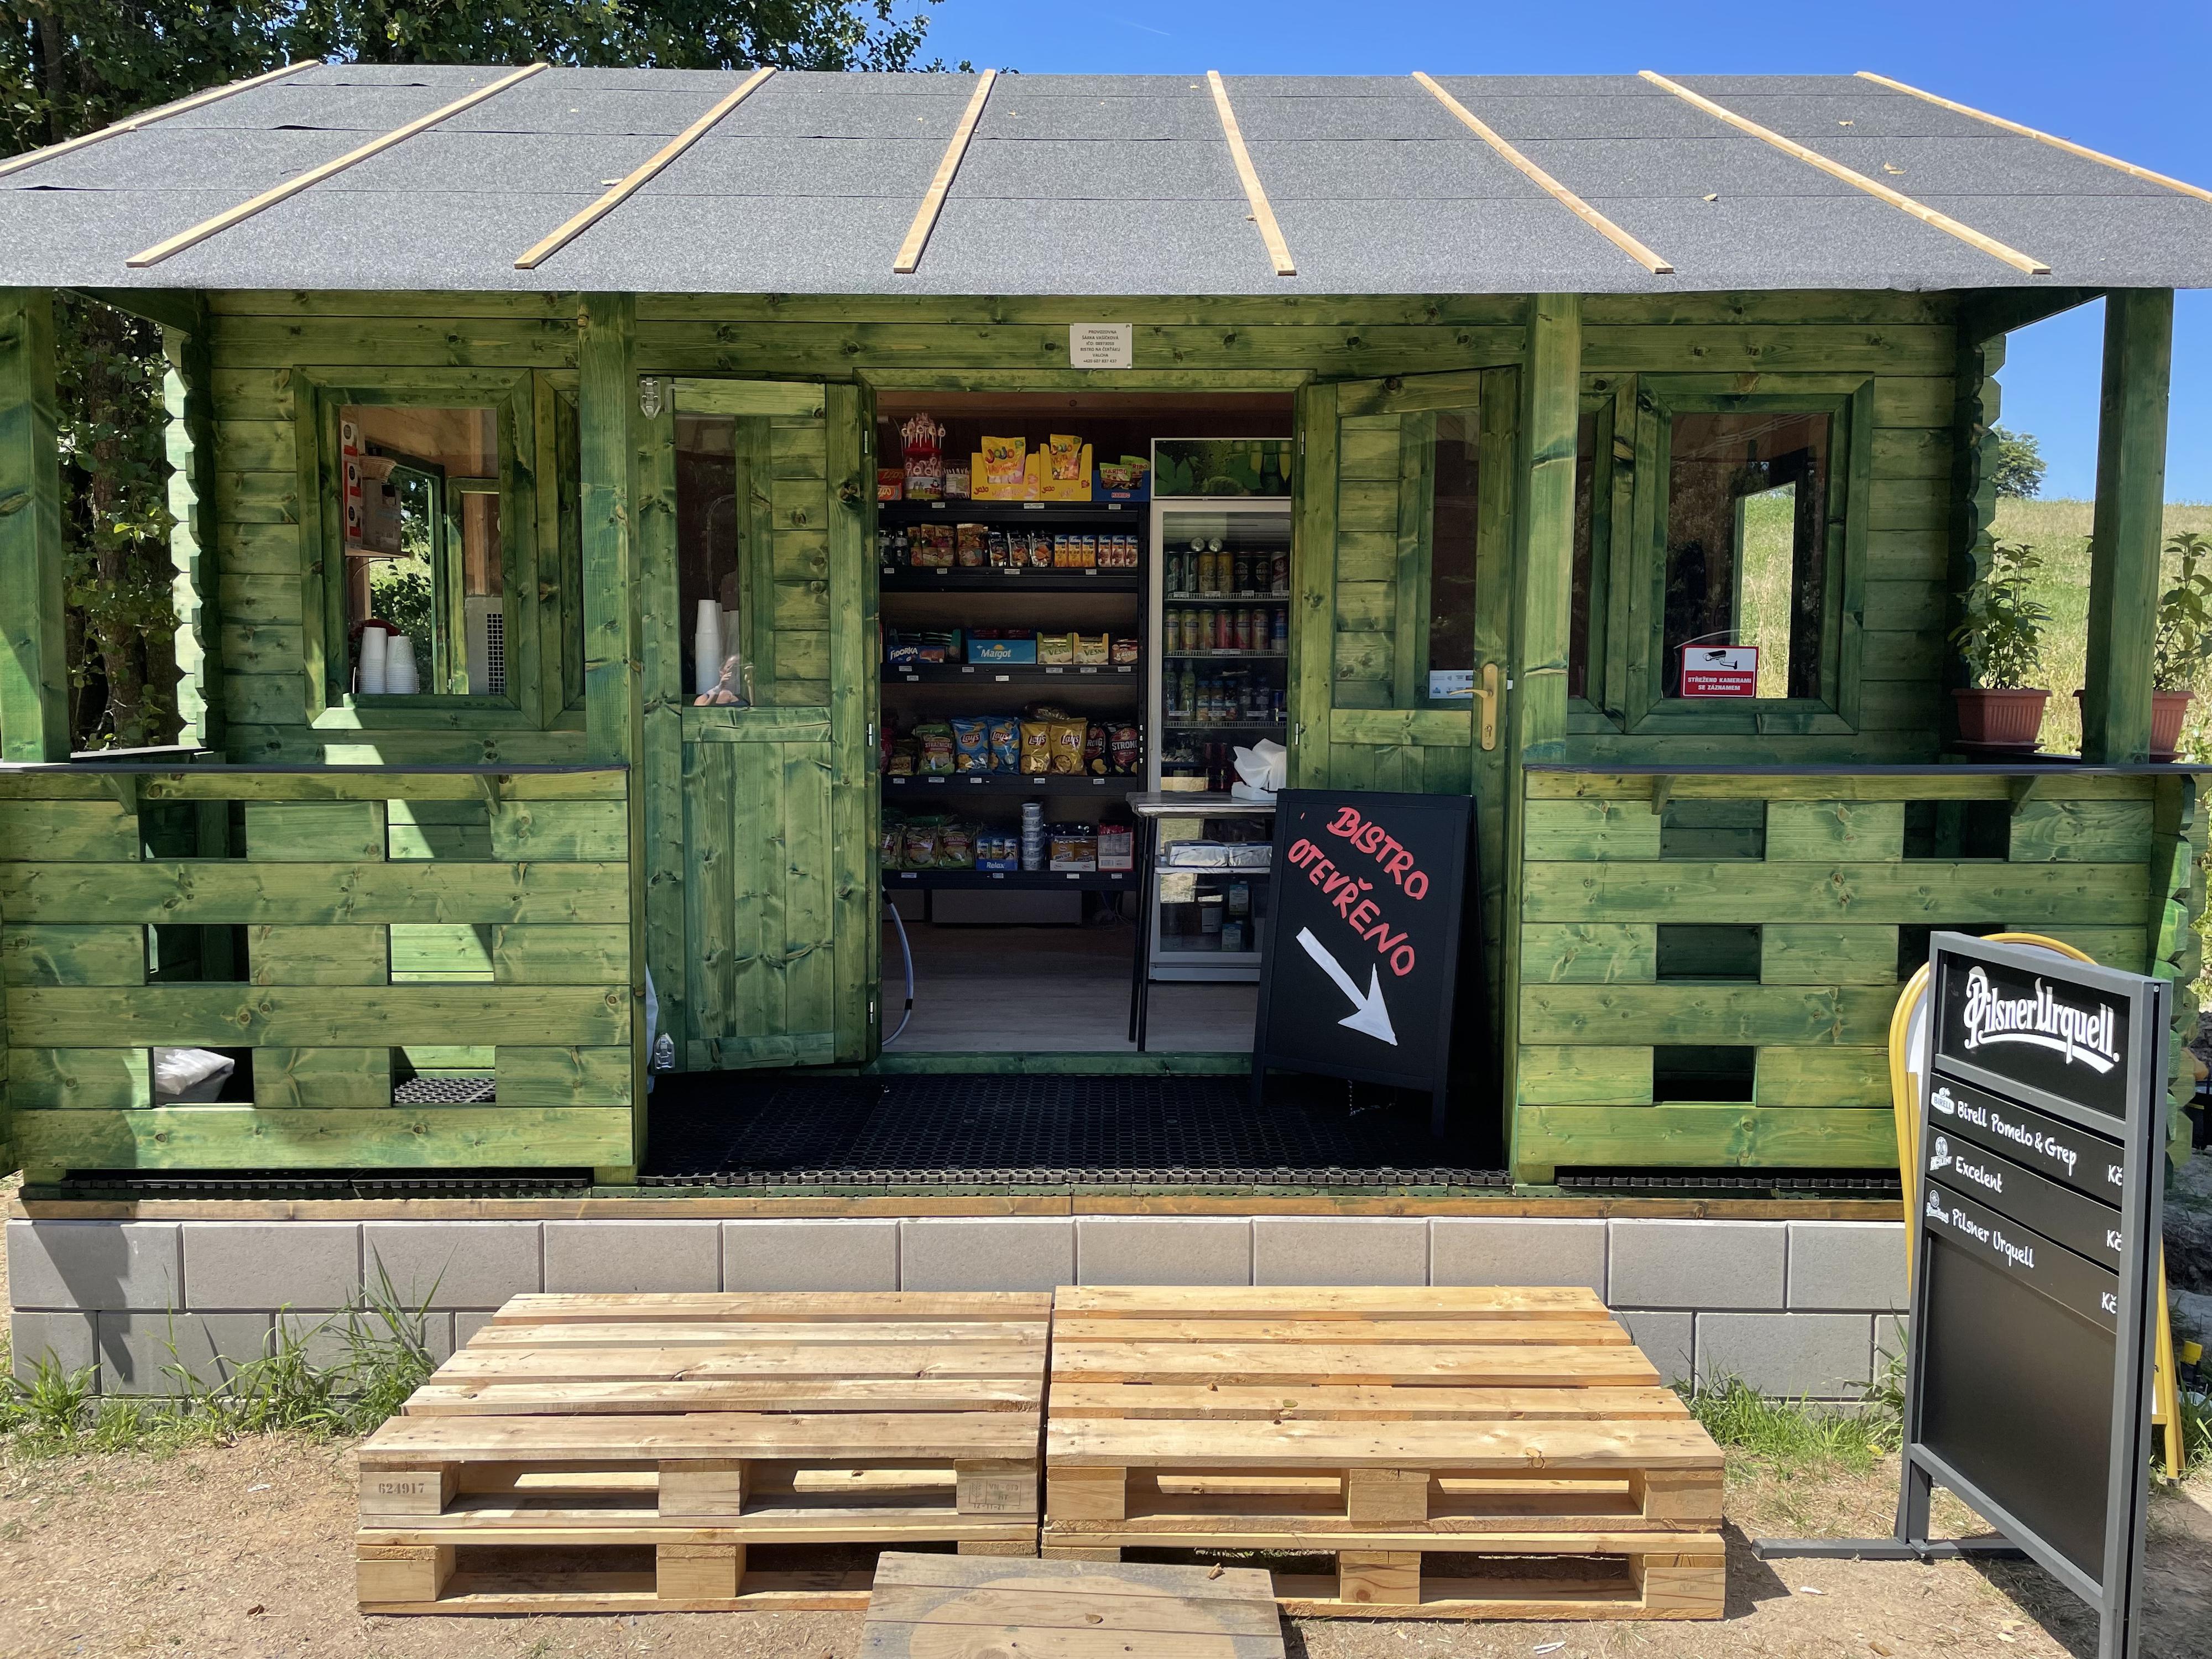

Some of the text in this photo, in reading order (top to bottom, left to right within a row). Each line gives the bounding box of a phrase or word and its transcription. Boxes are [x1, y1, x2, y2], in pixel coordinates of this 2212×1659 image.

[890, 646, 919, 661] FIDORKA
[980, 648, 1011, 660] Margot
[1087, 738, 1103, 747] RONG
[1326, 807, 1429, 900] BISTRO
[1287, 838, 1415, 976] OTEVŘENO
[1963, 965, 2114, 1065] Pilsner Urquell
[1933, 1097, 1952, 1110] BIRELL
[1958, 1100, 2078, 1177] Birell Pomelo & Grep
[1955, 1155, 2002, 1193] Excelent
[2107, 1164, 2123, 1186] Kč
[1952, 1208, 2035, 1269] Pilsner Urquell
[2106, 1229, 2122, 1251] Kč
[2101, 1292, 2117, 1314] Kč
[379, 1483, 425, 1494] 624917
